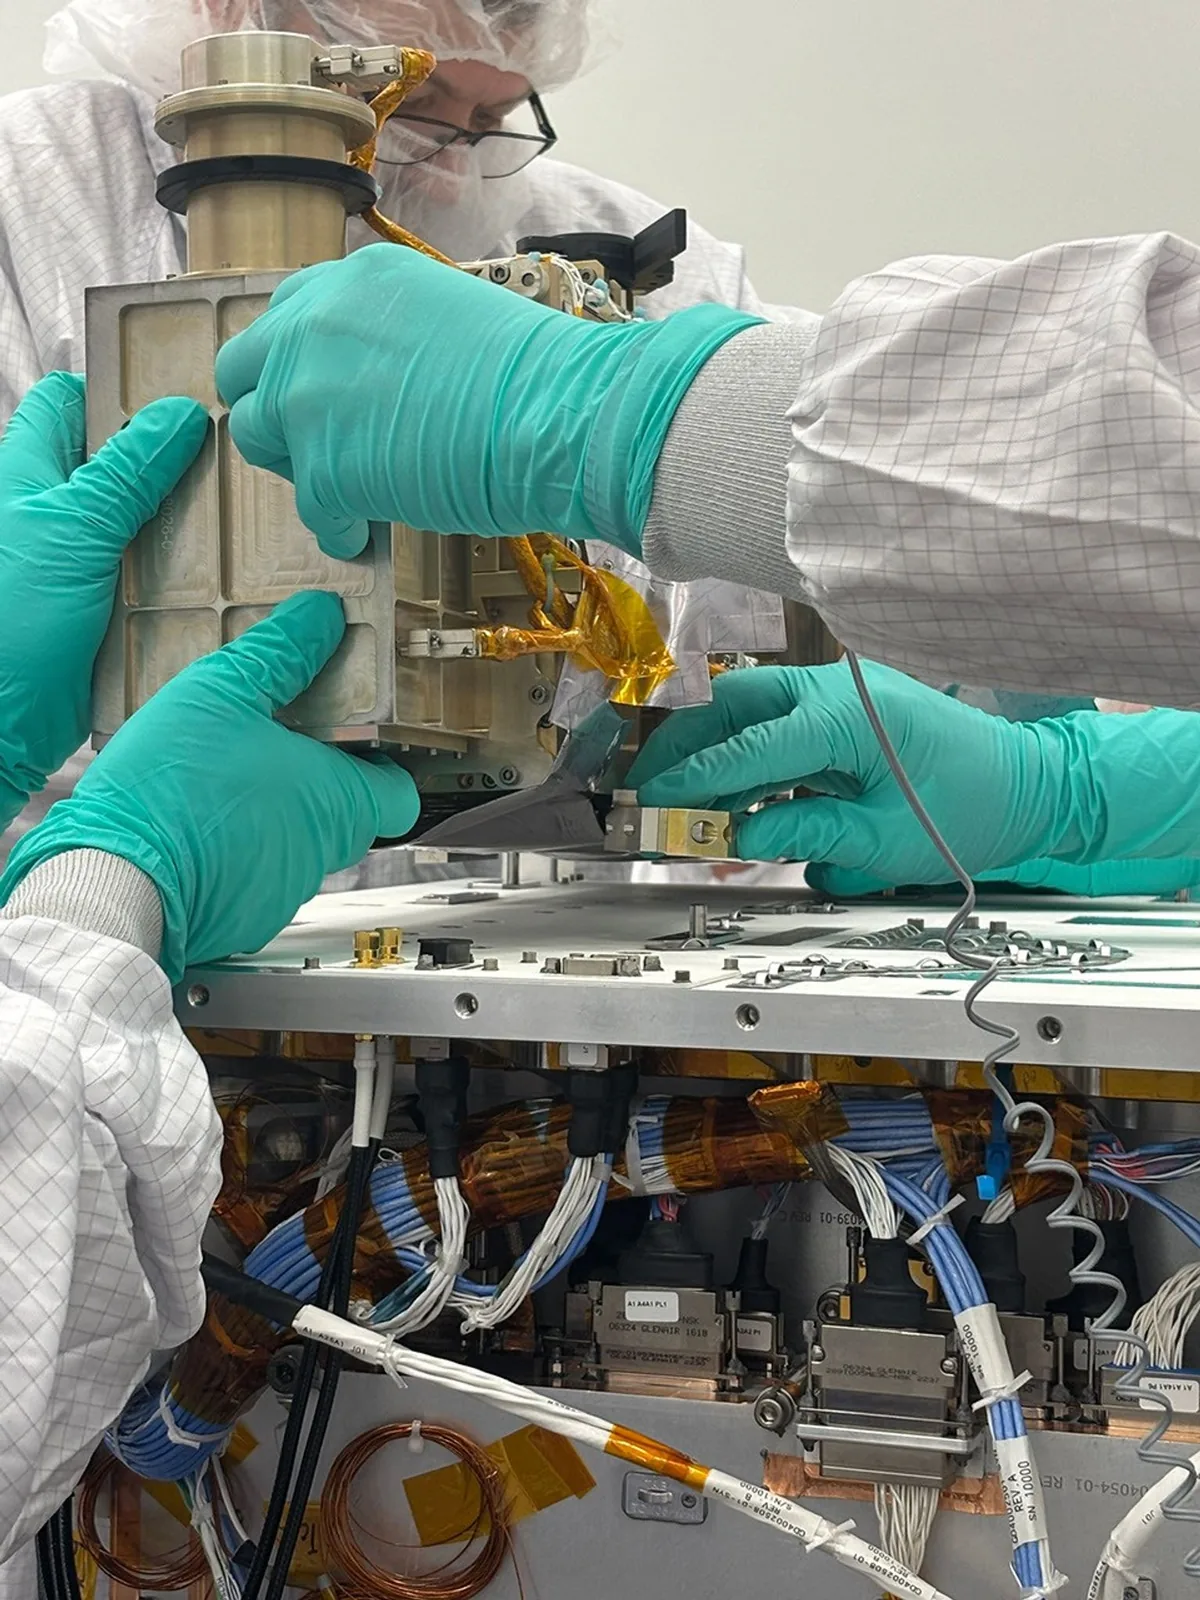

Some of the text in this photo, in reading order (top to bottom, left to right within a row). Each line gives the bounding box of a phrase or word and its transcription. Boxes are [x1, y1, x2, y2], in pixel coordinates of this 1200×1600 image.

[641, 1324, 681, 1335] GLENAIR
[962, 1324, 979, 1359] 10000
[1017, 1460, 1037, 1521] SN 10000
